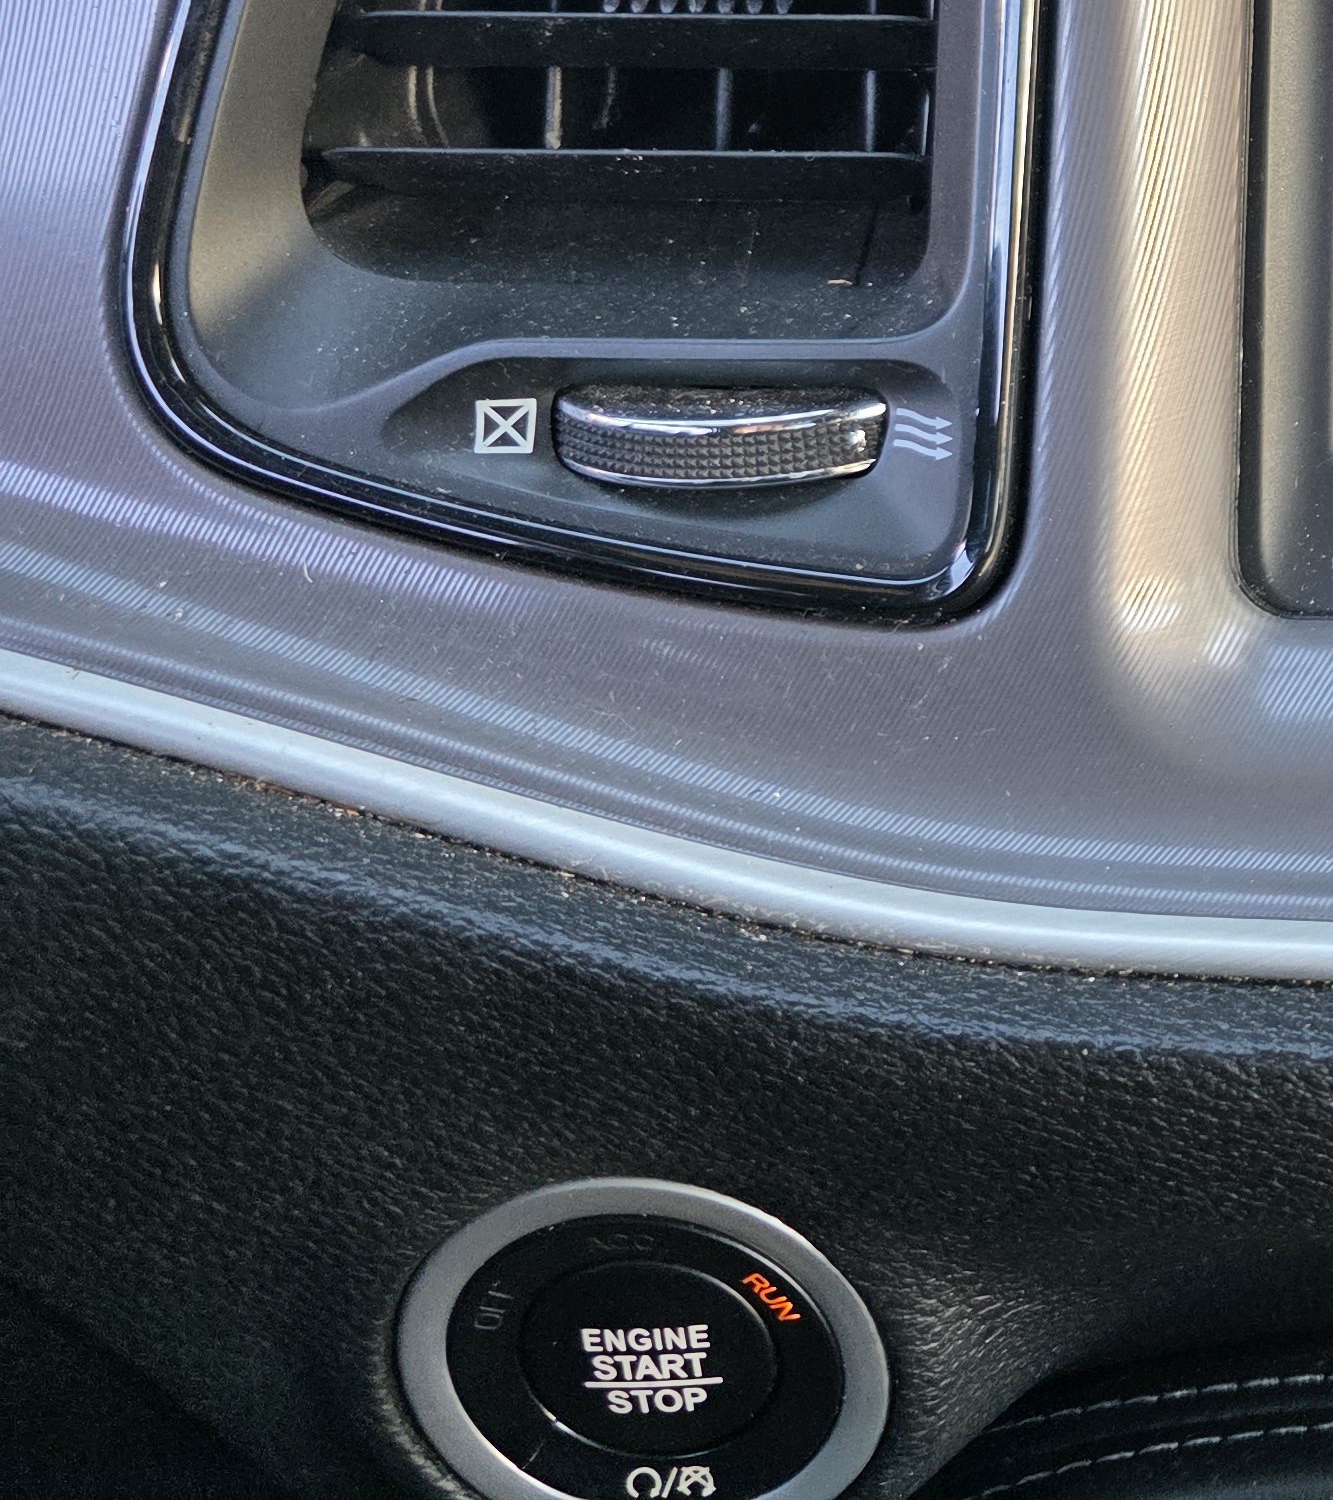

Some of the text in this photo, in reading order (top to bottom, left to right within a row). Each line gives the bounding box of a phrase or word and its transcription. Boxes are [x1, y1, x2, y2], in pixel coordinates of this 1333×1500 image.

[742, 1273, 801, 1321] RUN
[581, 1324, 711, 1352] ENGINE
[592, 1352, 706, 1380] START
[607, 1387, 707, 1414] STOP
